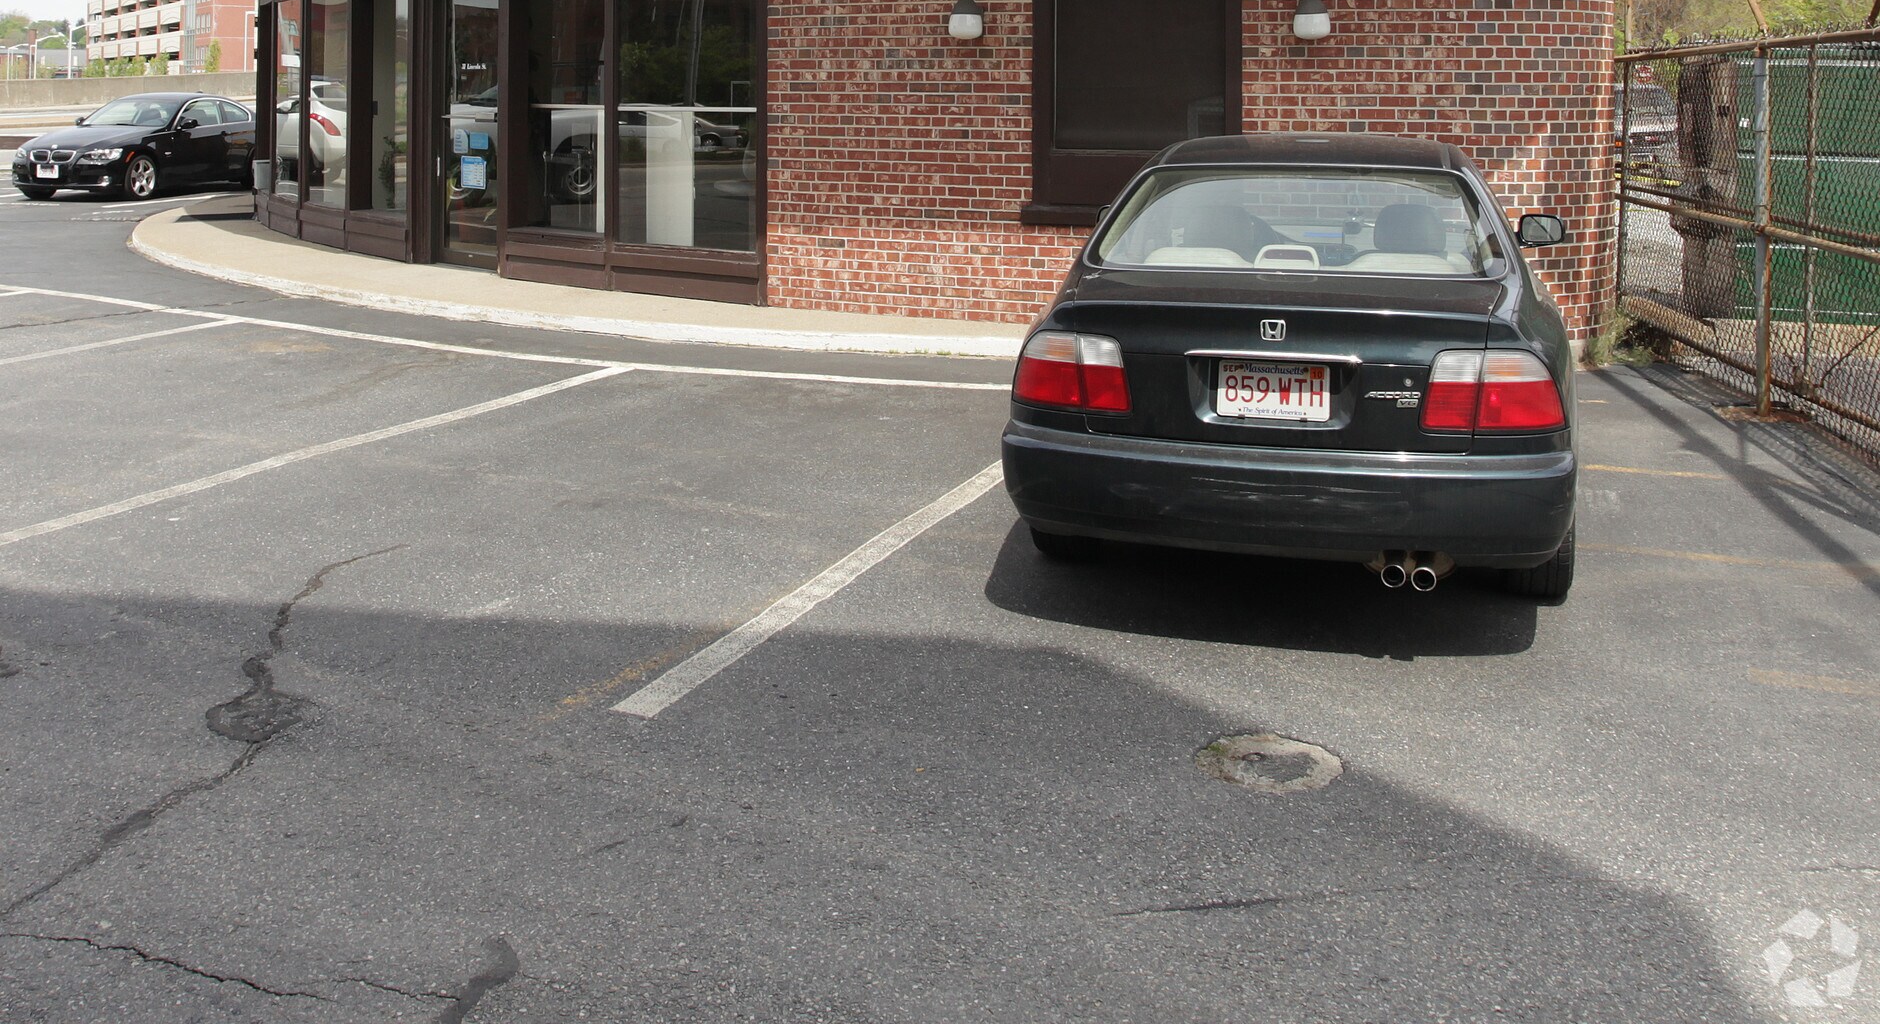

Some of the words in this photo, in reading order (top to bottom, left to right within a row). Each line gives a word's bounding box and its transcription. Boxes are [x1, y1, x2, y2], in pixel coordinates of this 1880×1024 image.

[1223, 364, 1238, 372] SEP
[1244, 363, 1305, 375] Massachusetts
[1313, 371, 1322, 379] 10
[1364, 391, 1421, 399] ACCORD
[1271, 408, 1278, 416] of
